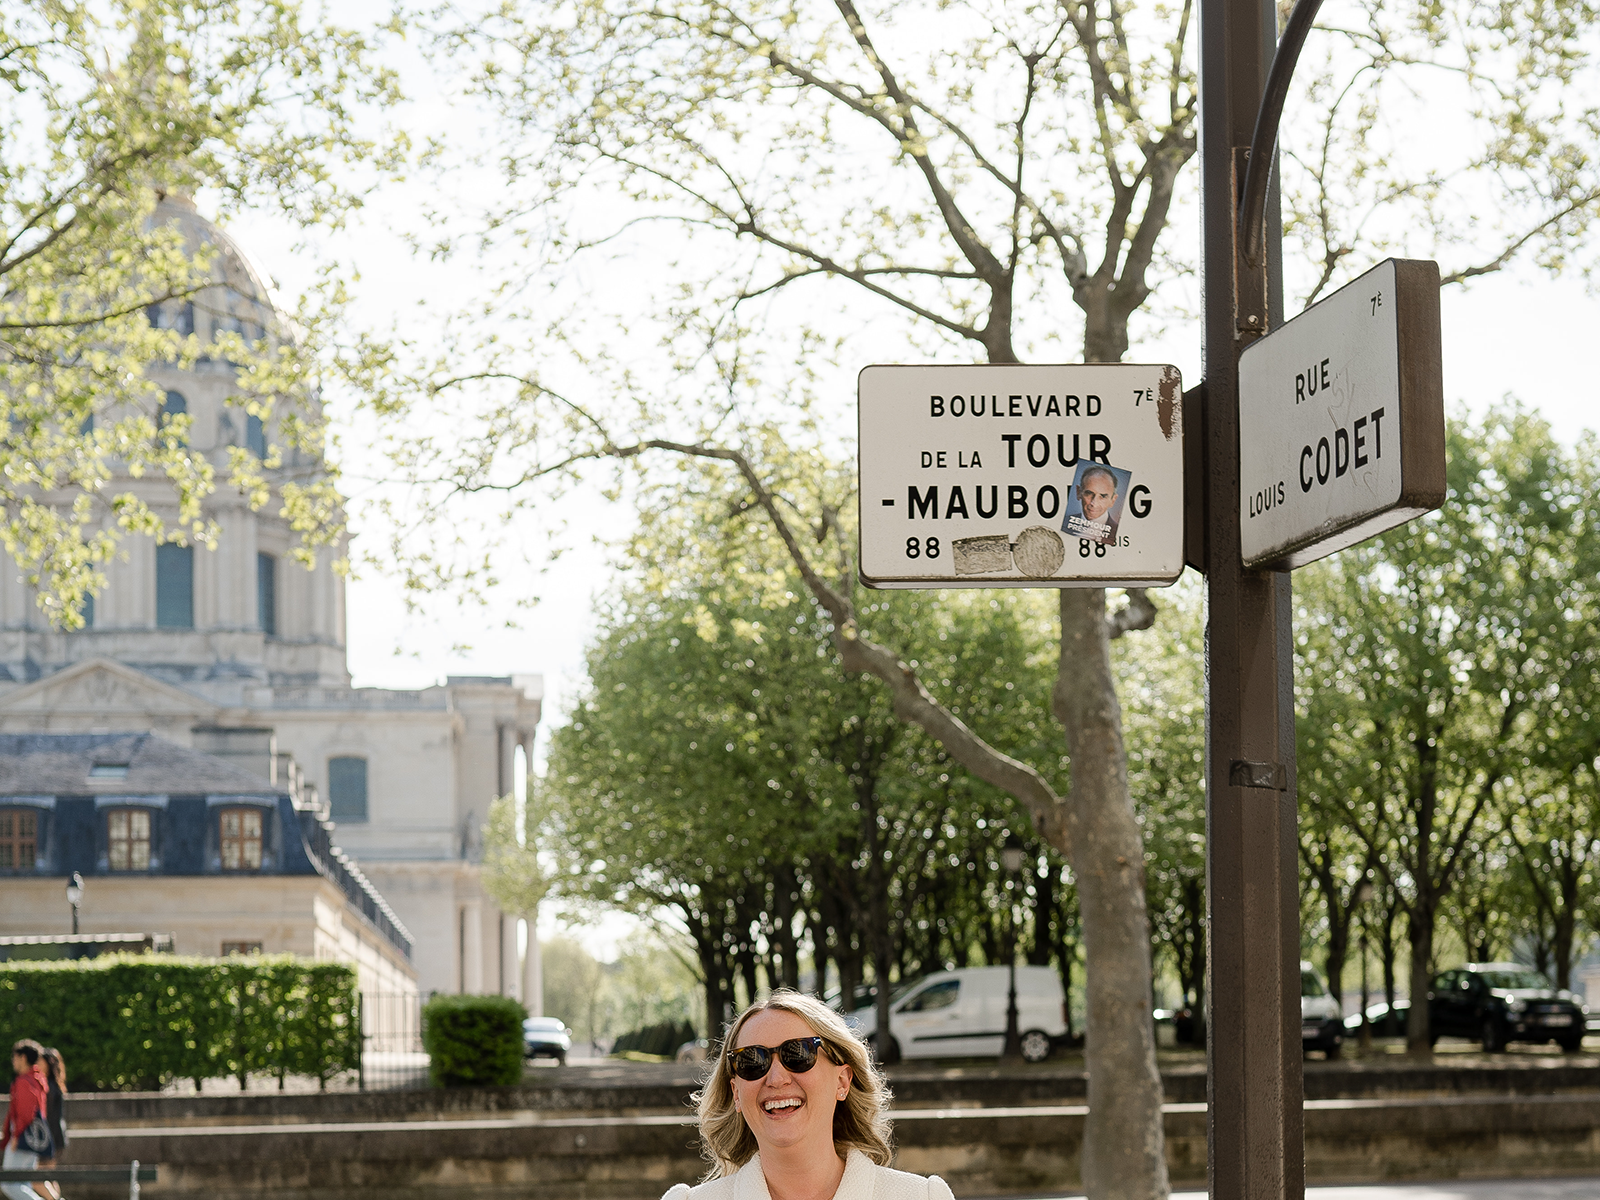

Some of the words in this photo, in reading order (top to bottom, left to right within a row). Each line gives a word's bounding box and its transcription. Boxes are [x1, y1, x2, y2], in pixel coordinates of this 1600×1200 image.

[1295, 358, 1331, 405] RUE
[930, 395, 1102, 417] BOULEVARD
[921, 451, 947, 468] DE
[958, 451, 982, 468] LA
[1002, 434, 1111, 468] TOUR
[1249, 480, 1286, 519] LOUIS
[1299, 406, 1385, 494] CODET
[882, 484, 1152, 519] -MAUBOG
[1068, 515, 1112, 533] ZEMMOUR
[906, 537, 940, 559] 88
